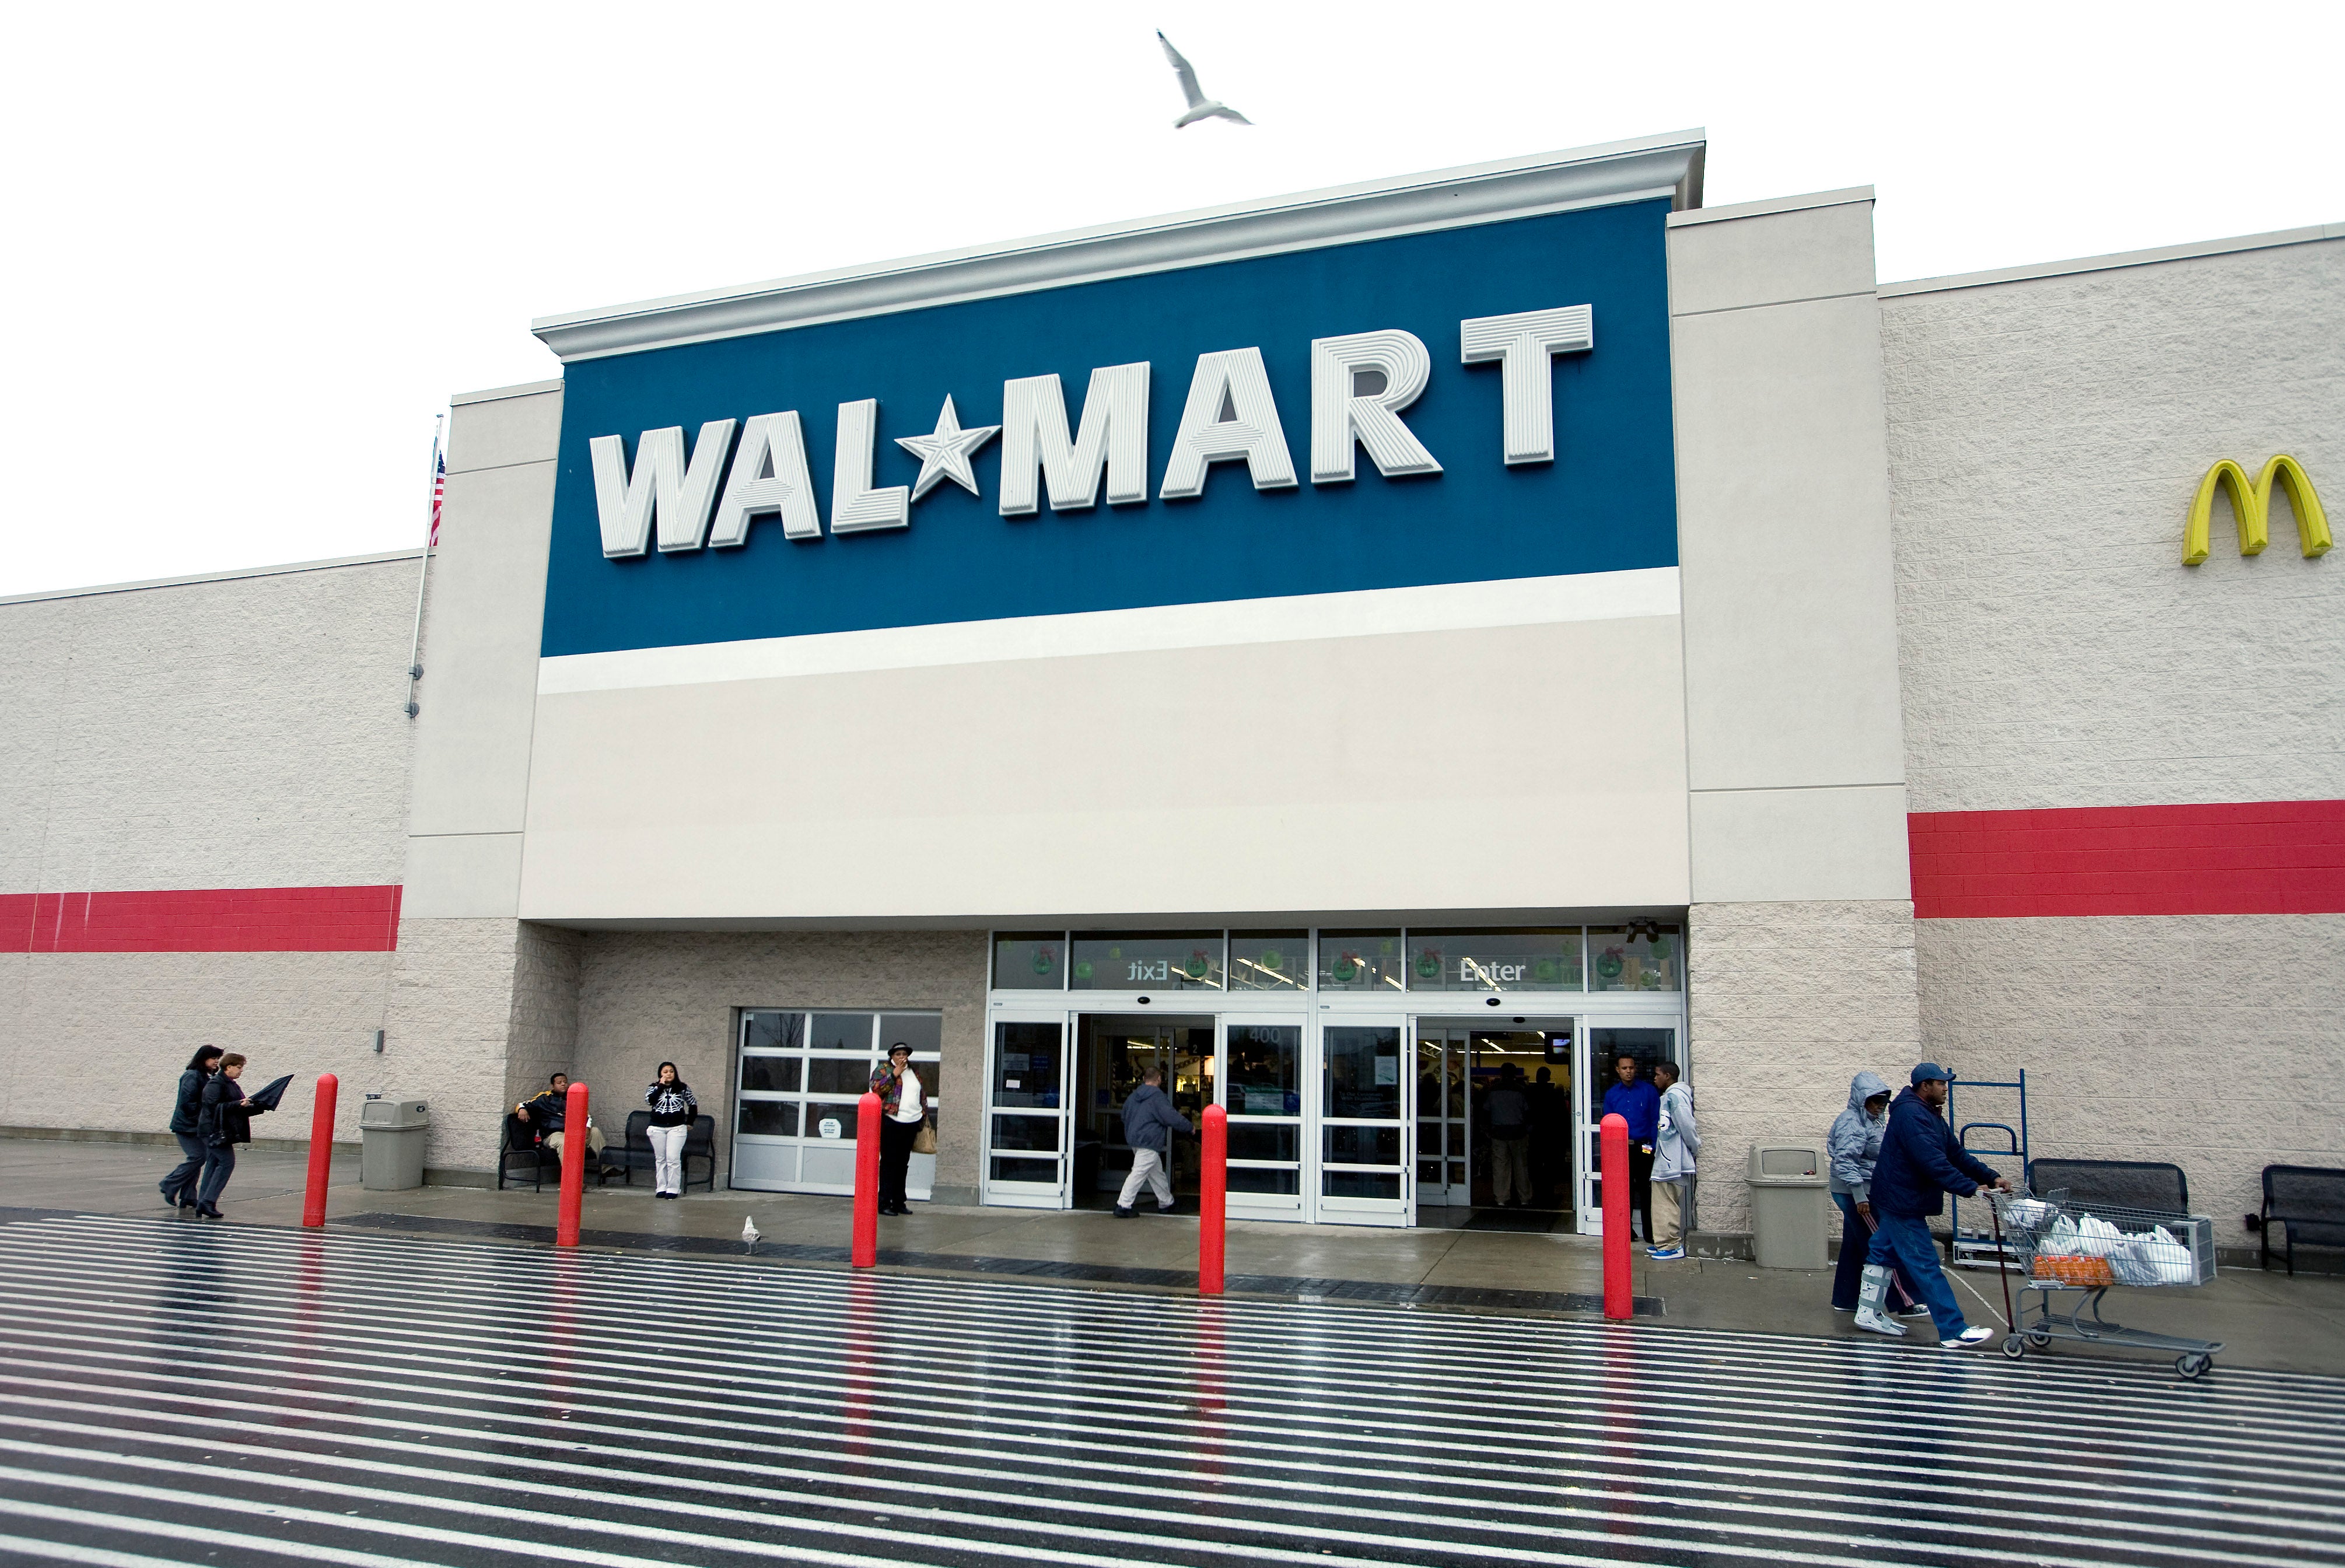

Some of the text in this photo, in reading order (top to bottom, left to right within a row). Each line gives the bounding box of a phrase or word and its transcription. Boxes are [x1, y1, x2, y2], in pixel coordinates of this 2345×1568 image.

[1461, 960, 1526, 981] Enter
[1250, 1027, 1280, 1043] 400
[1193, 1045, 1198, 1054] 2
